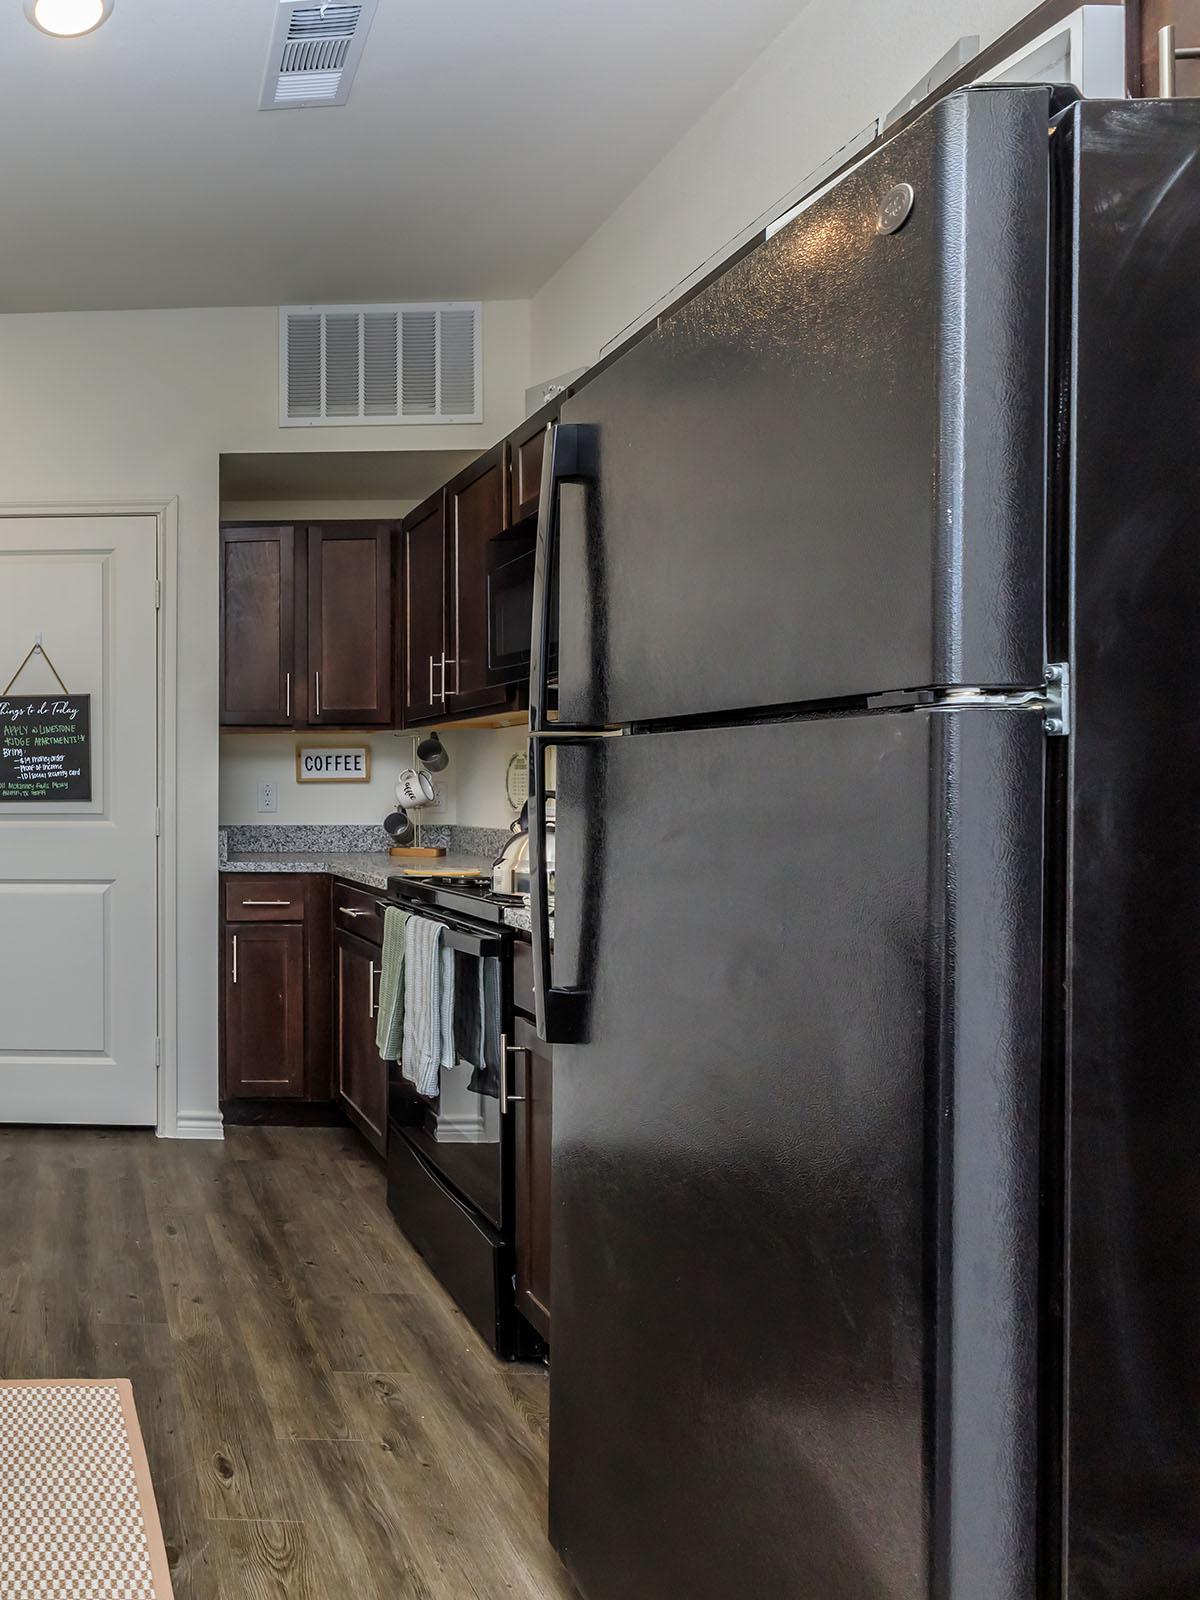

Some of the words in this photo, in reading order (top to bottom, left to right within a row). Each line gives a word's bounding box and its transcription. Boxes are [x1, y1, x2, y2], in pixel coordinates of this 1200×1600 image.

[26, 704, 36, 716] to
[37, 701, 49, 715] do
[51, 701, 80, 720] Today
[3, 725, 29, 737] APPLY
[305, 755, 362, 771] COFFEE
